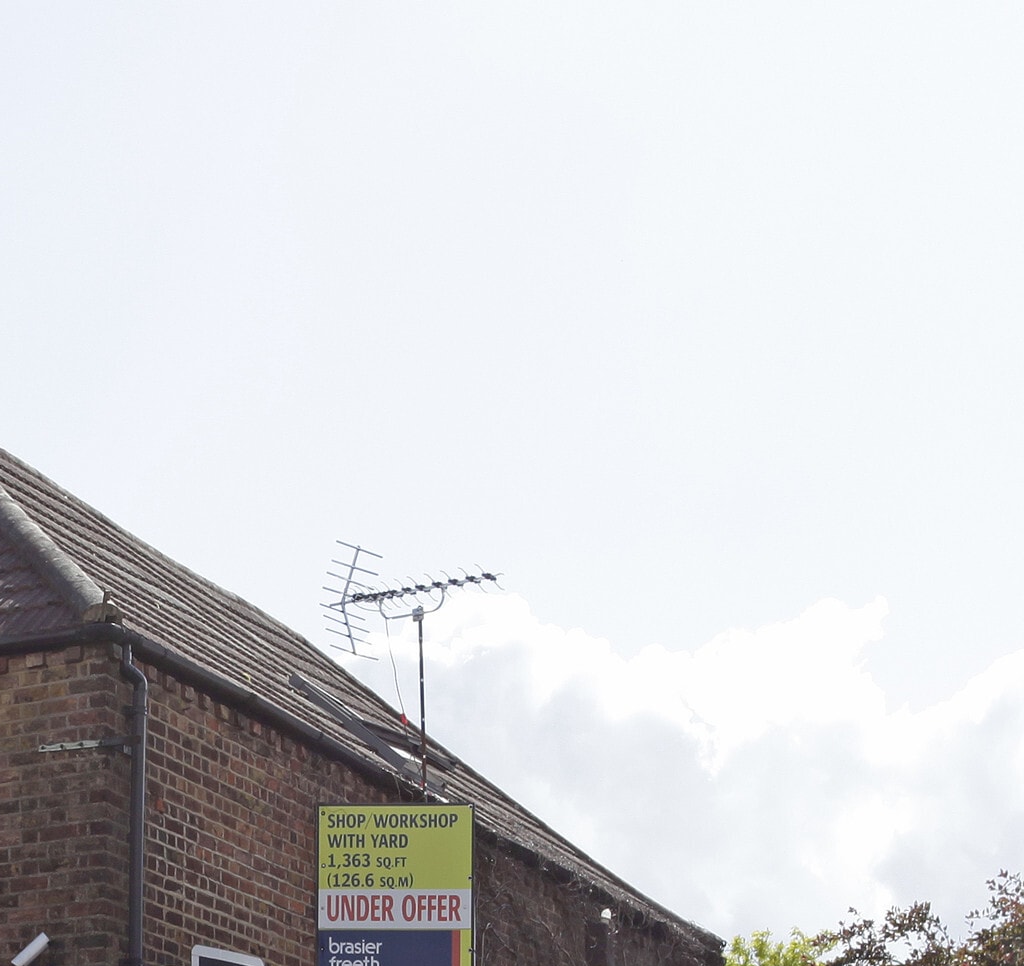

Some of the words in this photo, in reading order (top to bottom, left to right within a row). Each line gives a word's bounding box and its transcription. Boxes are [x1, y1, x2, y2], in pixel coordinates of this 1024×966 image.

[327, 813, 458, 830] SHOP/WORKSHOP
[327, 834, 365, 848] WITH
[371, 834, 409, 848] YARD
[327, 854, 371, 869] 1,363
[327, 873, 374, 888] (126.6
[326, 895, 394, 922] UNDER
[402, 895, 461, 922] OFFER
[328, 937, 382, 955] brasier
